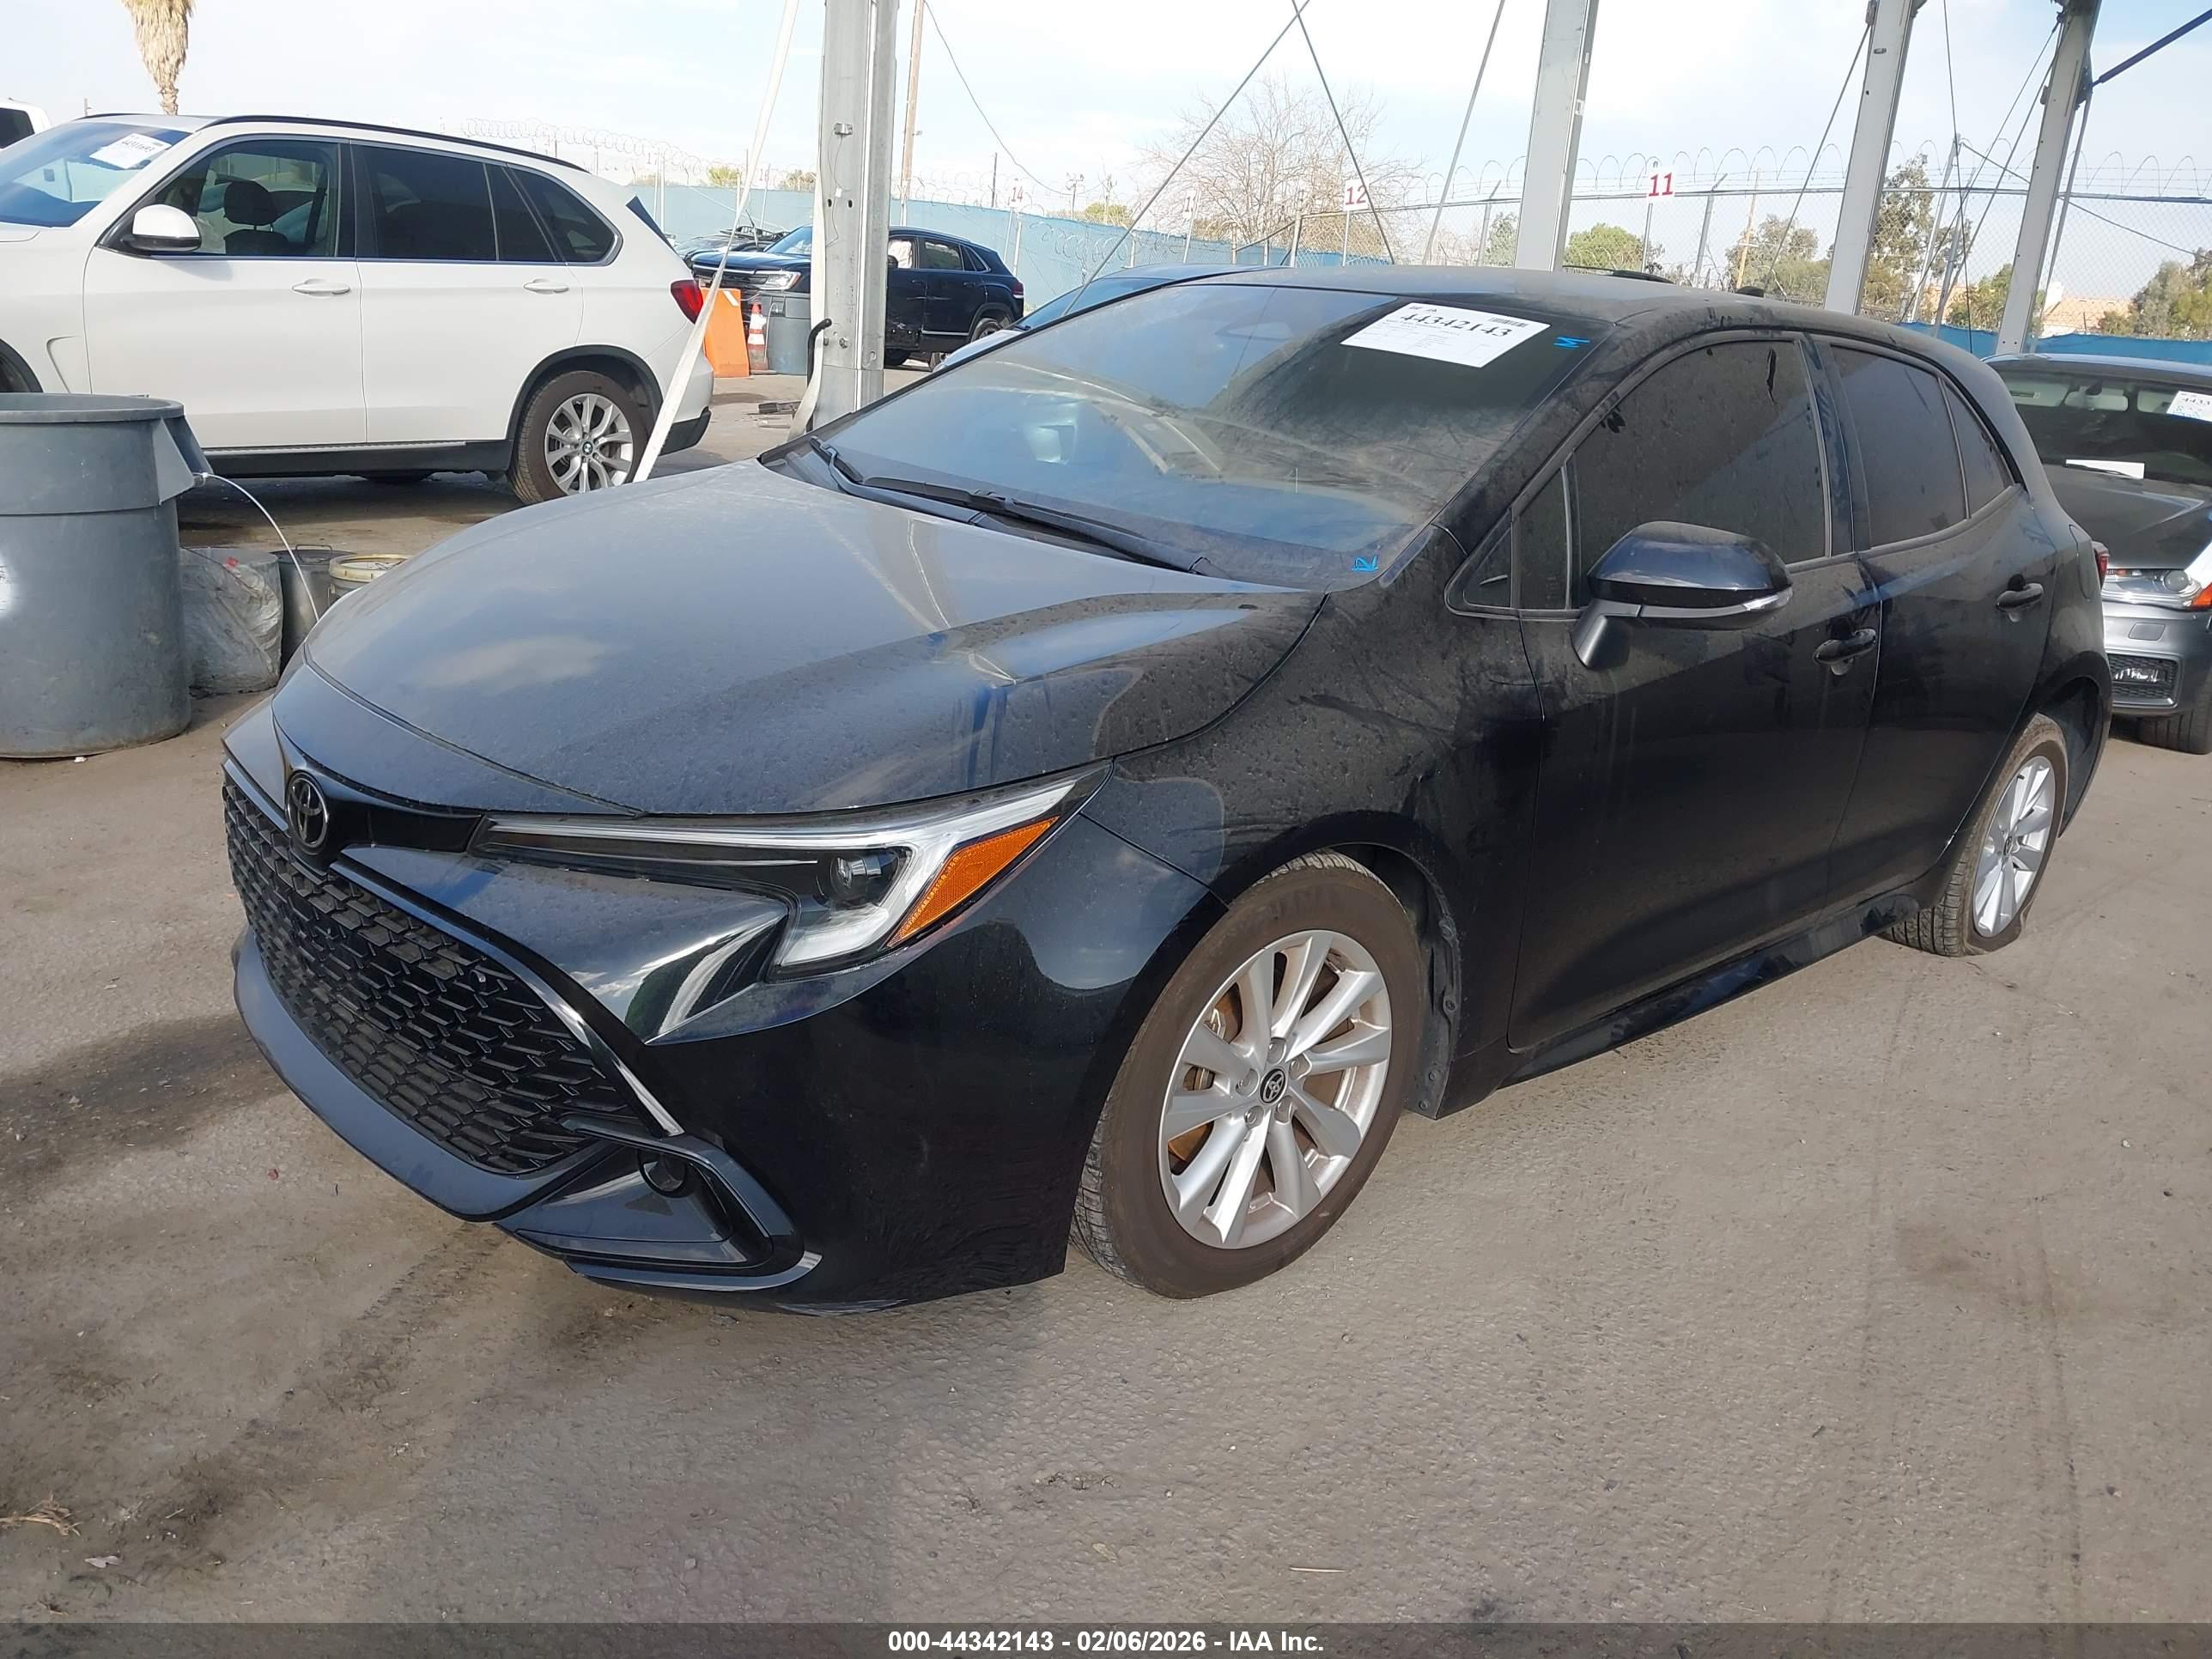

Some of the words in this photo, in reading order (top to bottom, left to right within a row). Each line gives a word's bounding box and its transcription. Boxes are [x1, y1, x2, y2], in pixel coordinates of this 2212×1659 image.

[1345, 185, 1367, 205] 12
[1648, 172, 1674, 197] 11
[1401, 313, 1513, 337] 44342143
